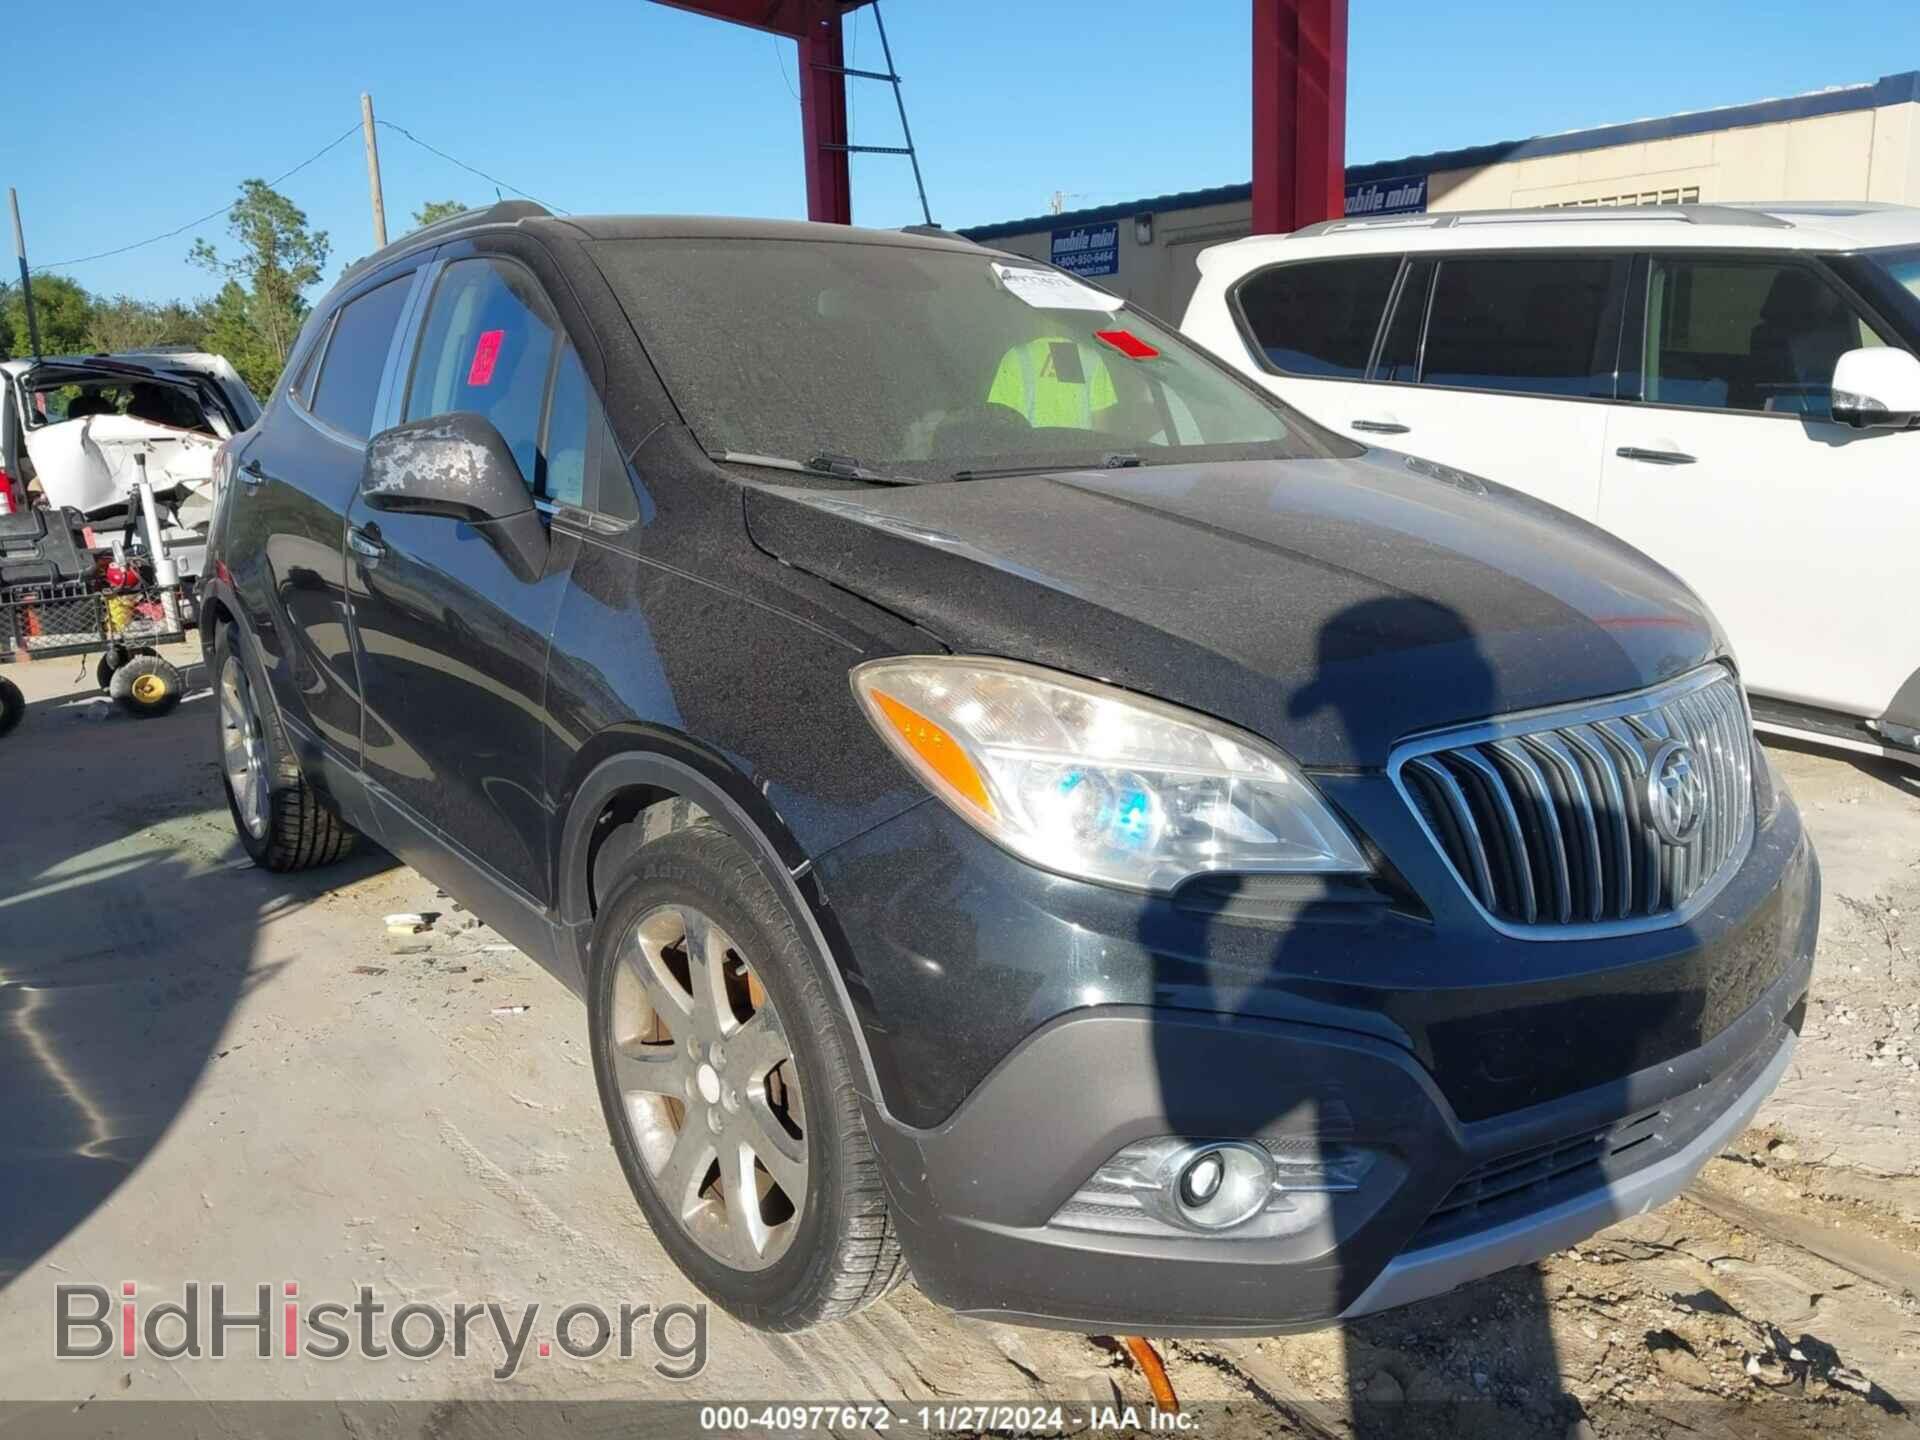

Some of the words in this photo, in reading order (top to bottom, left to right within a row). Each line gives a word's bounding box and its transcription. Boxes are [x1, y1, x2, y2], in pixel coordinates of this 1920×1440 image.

[1344, 184, 1385, 213] obile
[1385, 182, 1425, 208] mini
[1053, 228, 1090, 253] mobile
[1090, 227, 1117, 248] mini
